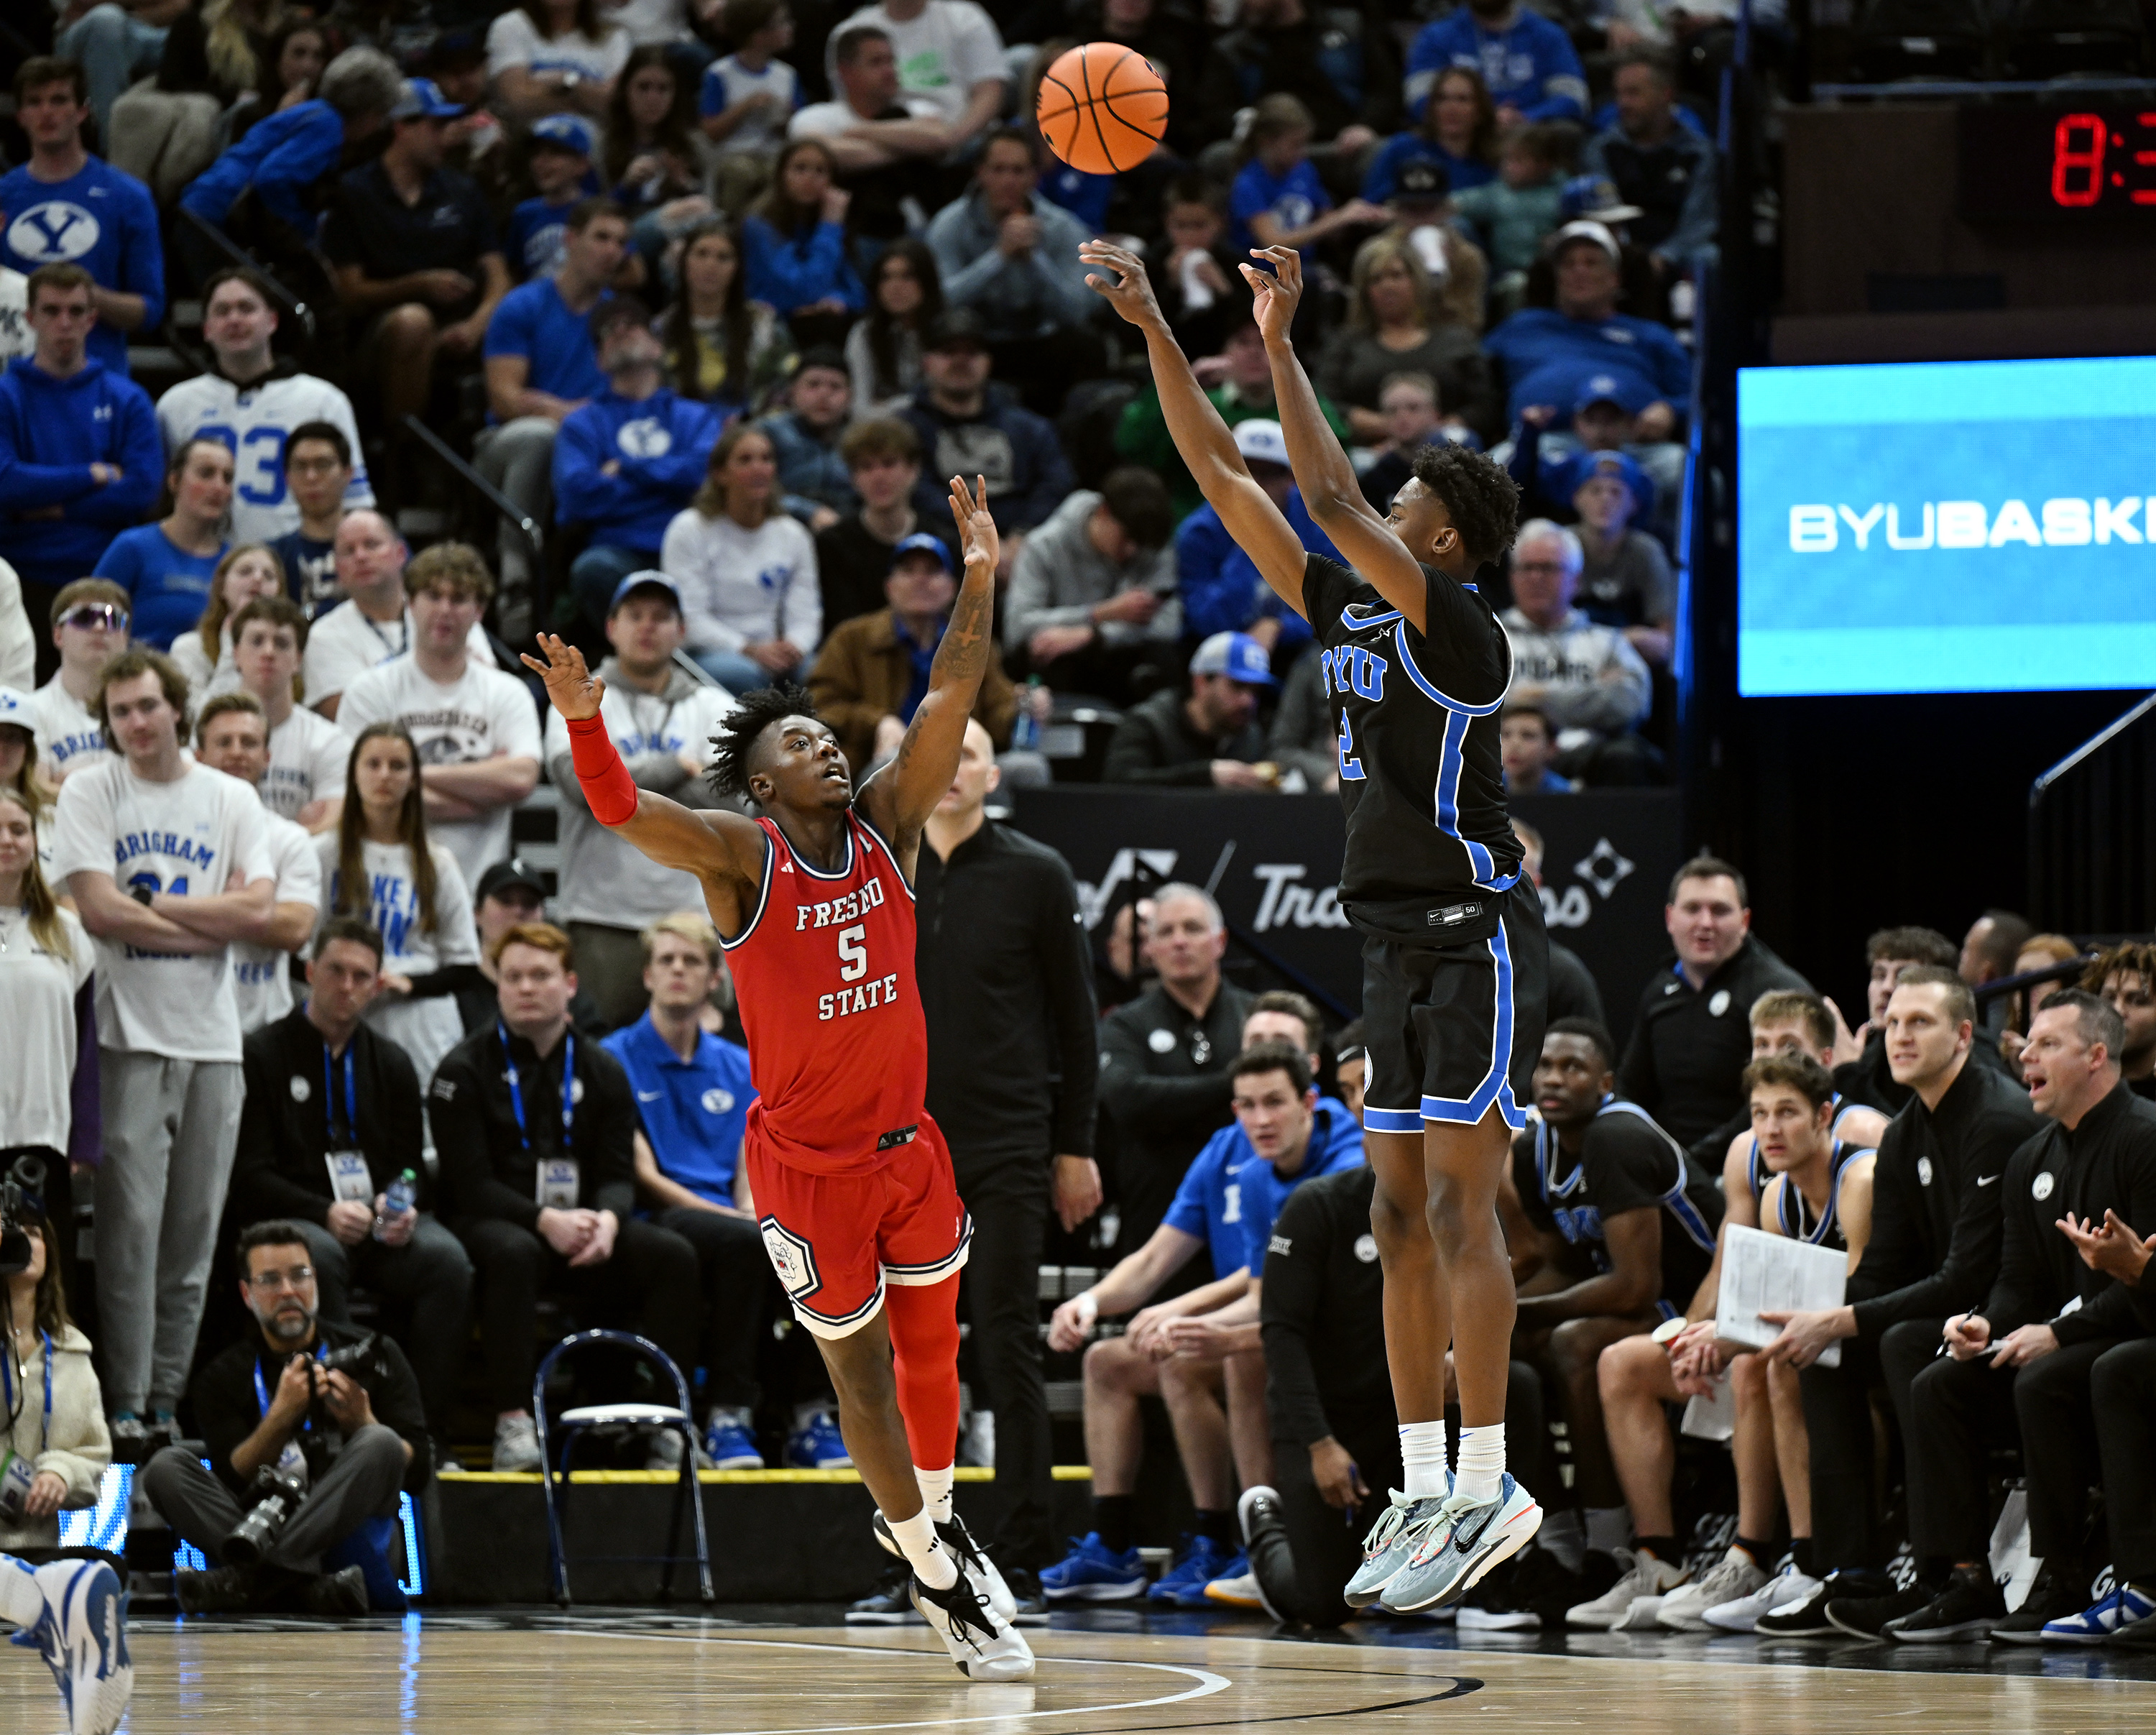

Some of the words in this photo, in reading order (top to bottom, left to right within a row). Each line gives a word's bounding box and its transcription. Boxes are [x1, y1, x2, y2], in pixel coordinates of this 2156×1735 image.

[1320, 645, 1388, 702] BYU
[1338, 706, 1368, 781] 2
[115, 831, 214, 871] BRIGHAM
[795, 876, 885, 931] FRESNO
[837, 922, 867, 983] 5
[818, 972, 898, 1021] STATE
